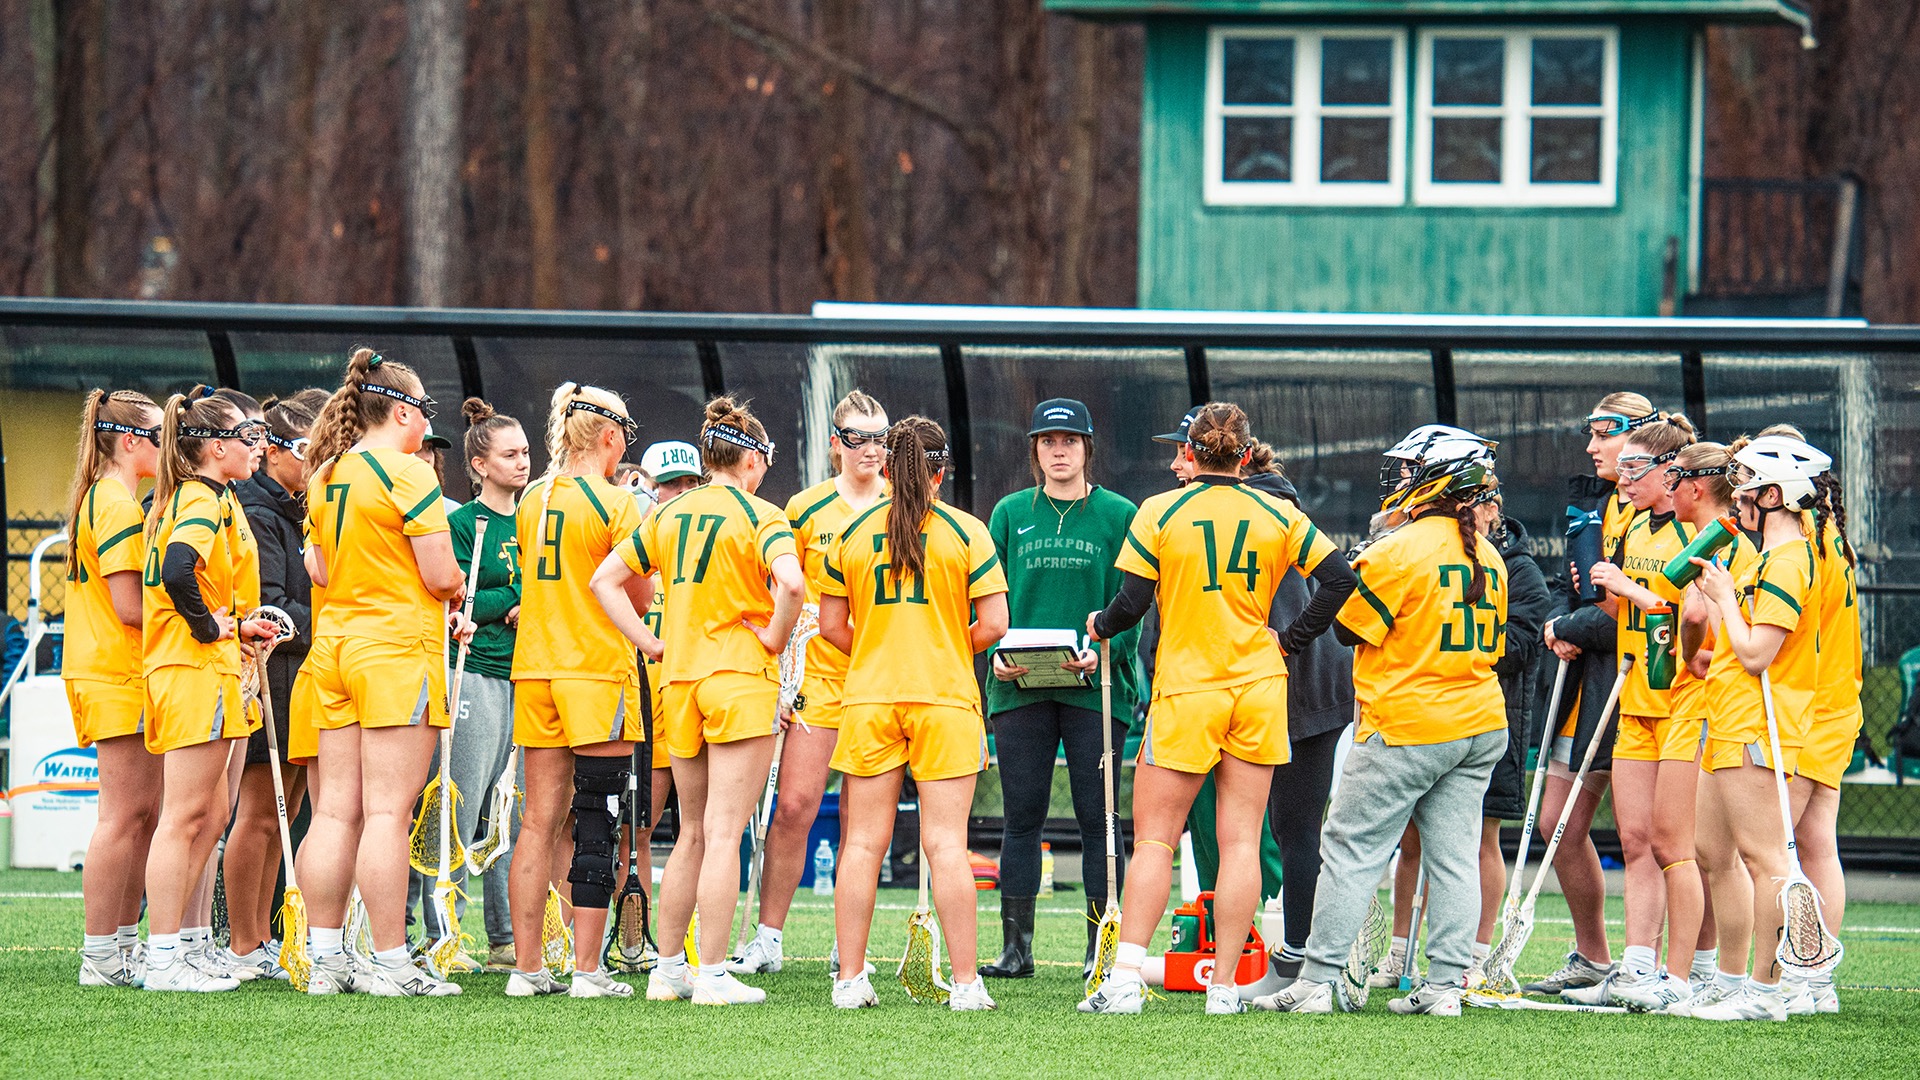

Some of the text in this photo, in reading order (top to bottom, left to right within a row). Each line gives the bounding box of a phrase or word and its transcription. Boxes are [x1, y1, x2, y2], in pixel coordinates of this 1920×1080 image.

[366, 384, 385, 393] GAIT
[386, 389, 405, 399] GAIT
[405, 396, 421, 406] GAIT
[575, 402, 597, 411] STX
[602, 409, 622, 423] STX
[115, 426, 133, 434] GAIT
[740, 433, 756, 445] GAIT
[660, 447, 696, 468] PORT
[1660, 451, 1677, 461] STX
[1698, 467, 1721, 476] STX
[326, 483, 351, 551] 7
[537, 509, 565, 581] 9
[673, 513, 727, 585] 17
[1017, 538, 1102, 558] BROCKPORT
[1192, 519, 1261, 593] 14
[872, 532, 929, 606] 21
[1624, 555, 1667, 574] OCKPORT
[1438, 564, 1500, 653] 35
[277, 795, 287, 818] GAIT
[1525, 813, 1535, 835] GAIT
[1554, 822, 1565, 844] GAIT
